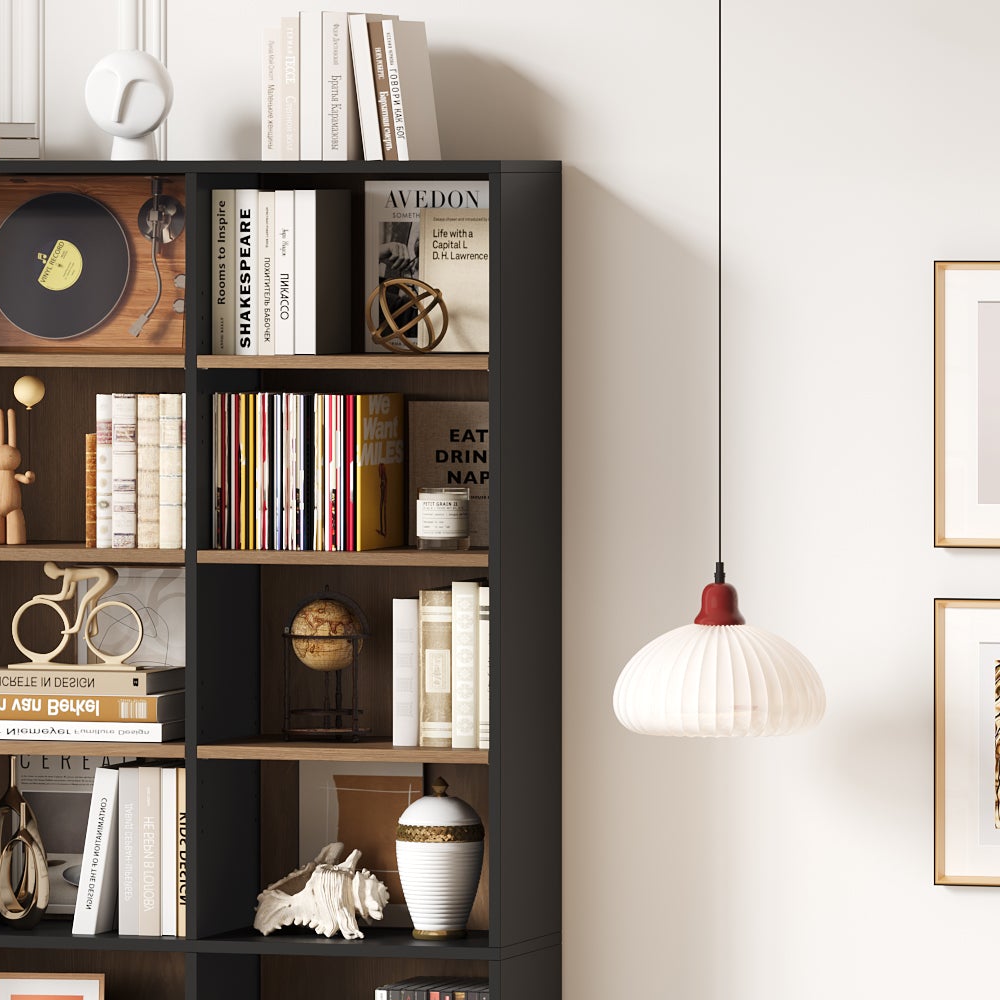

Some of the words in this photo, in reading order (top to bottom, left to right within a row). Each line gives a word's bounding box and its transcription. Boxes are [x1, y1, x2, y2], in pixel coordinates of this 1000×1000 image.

[390, 68, 401, 106] ГОВОРИ
[394, 108, 403, 123] КАК
[396, 126, 405, 140] БОГ
[385, 190, 480, 208] AVEDON
[217, 200, 228, 243] Inspire
[432, 229, 448, 238] Life
[449, 229, 467, 238] with
[217, 246, 226, 260] to
[432, 240, 461, 251] Capital
[462, 240, 468, 249] L
[432, 251, 440, 260] D.
[441, 251, 449, 260] H.
[450, 251, 489, 260] Lawrence
[40, 265, 53, 284] VINYL
[49, 240, 65, 266] RECORD
[217, 263, 226, 305] Rooms
[239, 208, 251, 348] SHAKESPEARE
[263, 257, 271, 306] ПОХИТИТЕЛЬ
[280, 273, 289, 320] ПИКАССО
[263, 308, 271, 343] БАБОЧЕК
[368, 395, 391, 416] We
[363, 416, 399, 440] Want
[449, 429, 489, 443] EAT
[360, 441, 404, 466] MILES
[447, 470, 489, 485] NAP
